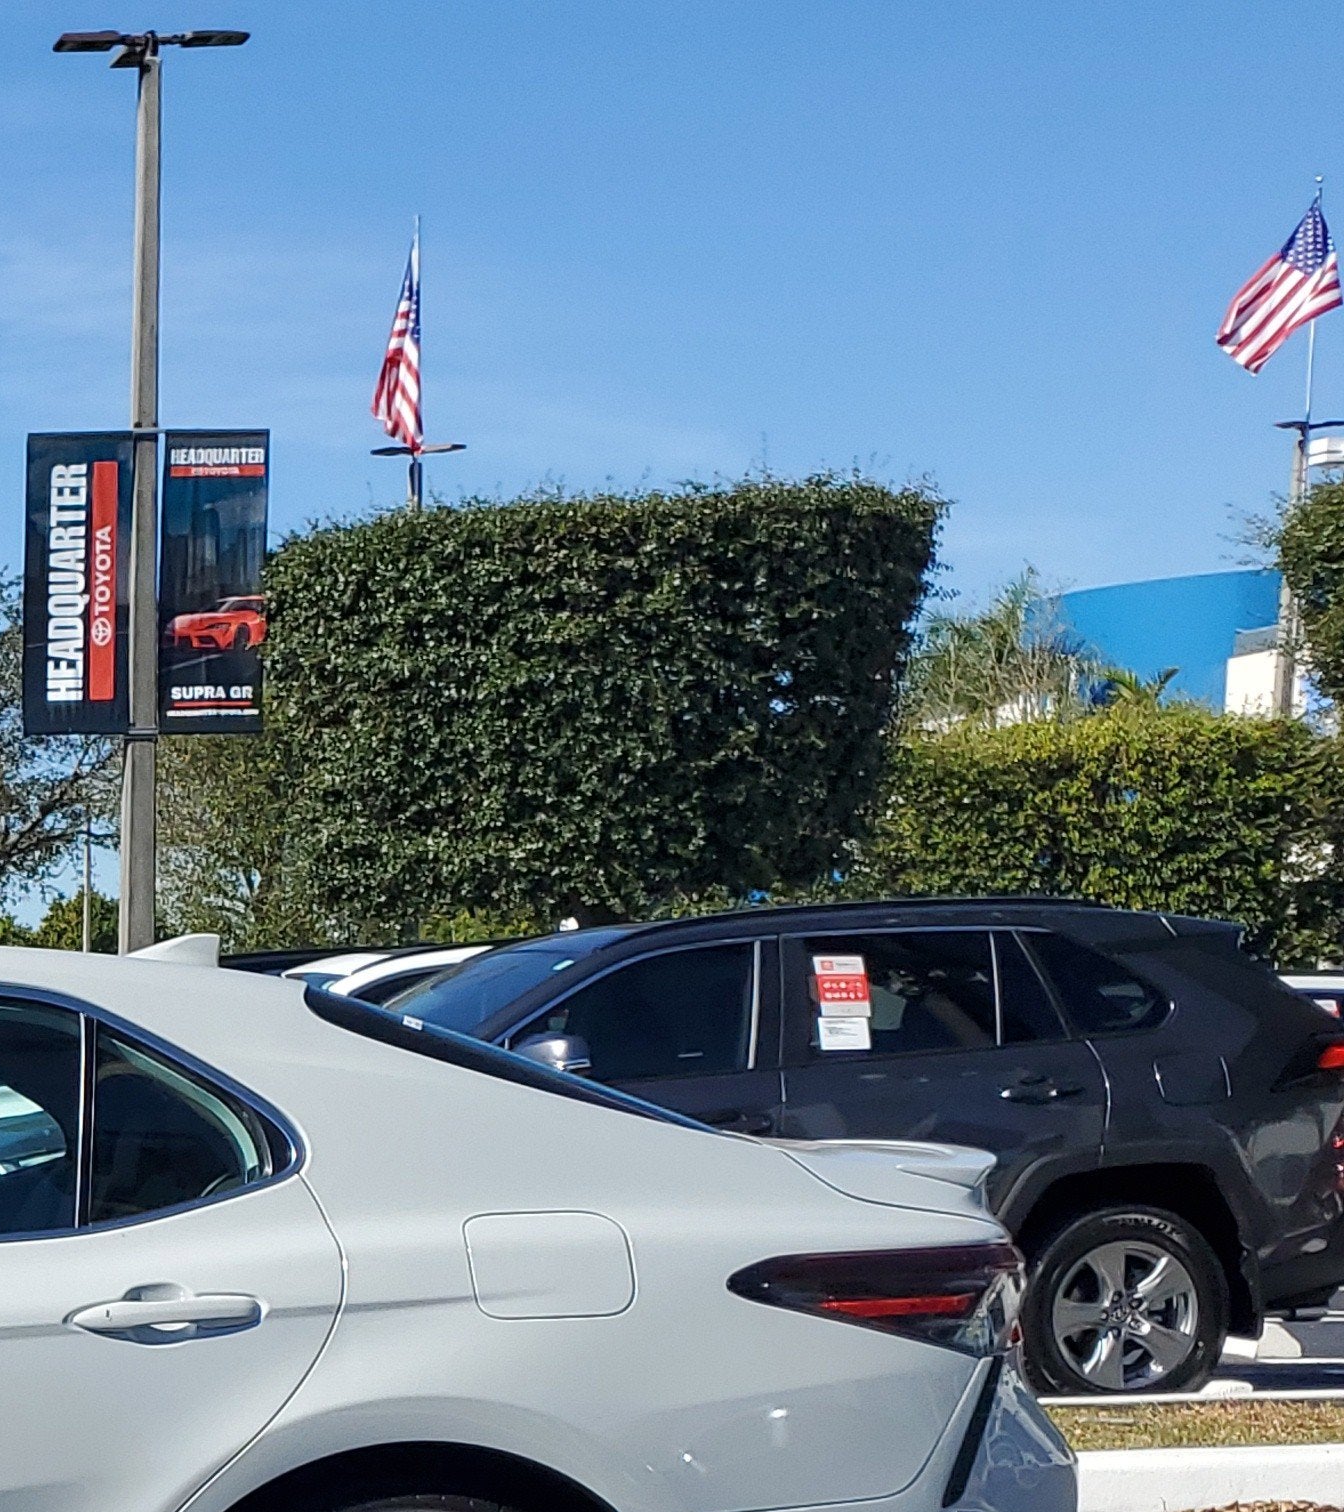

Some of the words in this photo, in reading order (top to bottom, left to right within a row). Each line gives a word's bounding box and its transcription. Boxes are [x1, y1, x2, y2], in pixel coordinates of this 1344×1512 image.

[170, 448, 264, 466] HEADQUARTER
[47, 463, 90, 701] HEADQUARTER
[94, 525, 112, 617] TOYOTA
[171, 685, 226, 699] SUPRA
[229, 685, 253, 699] GR
